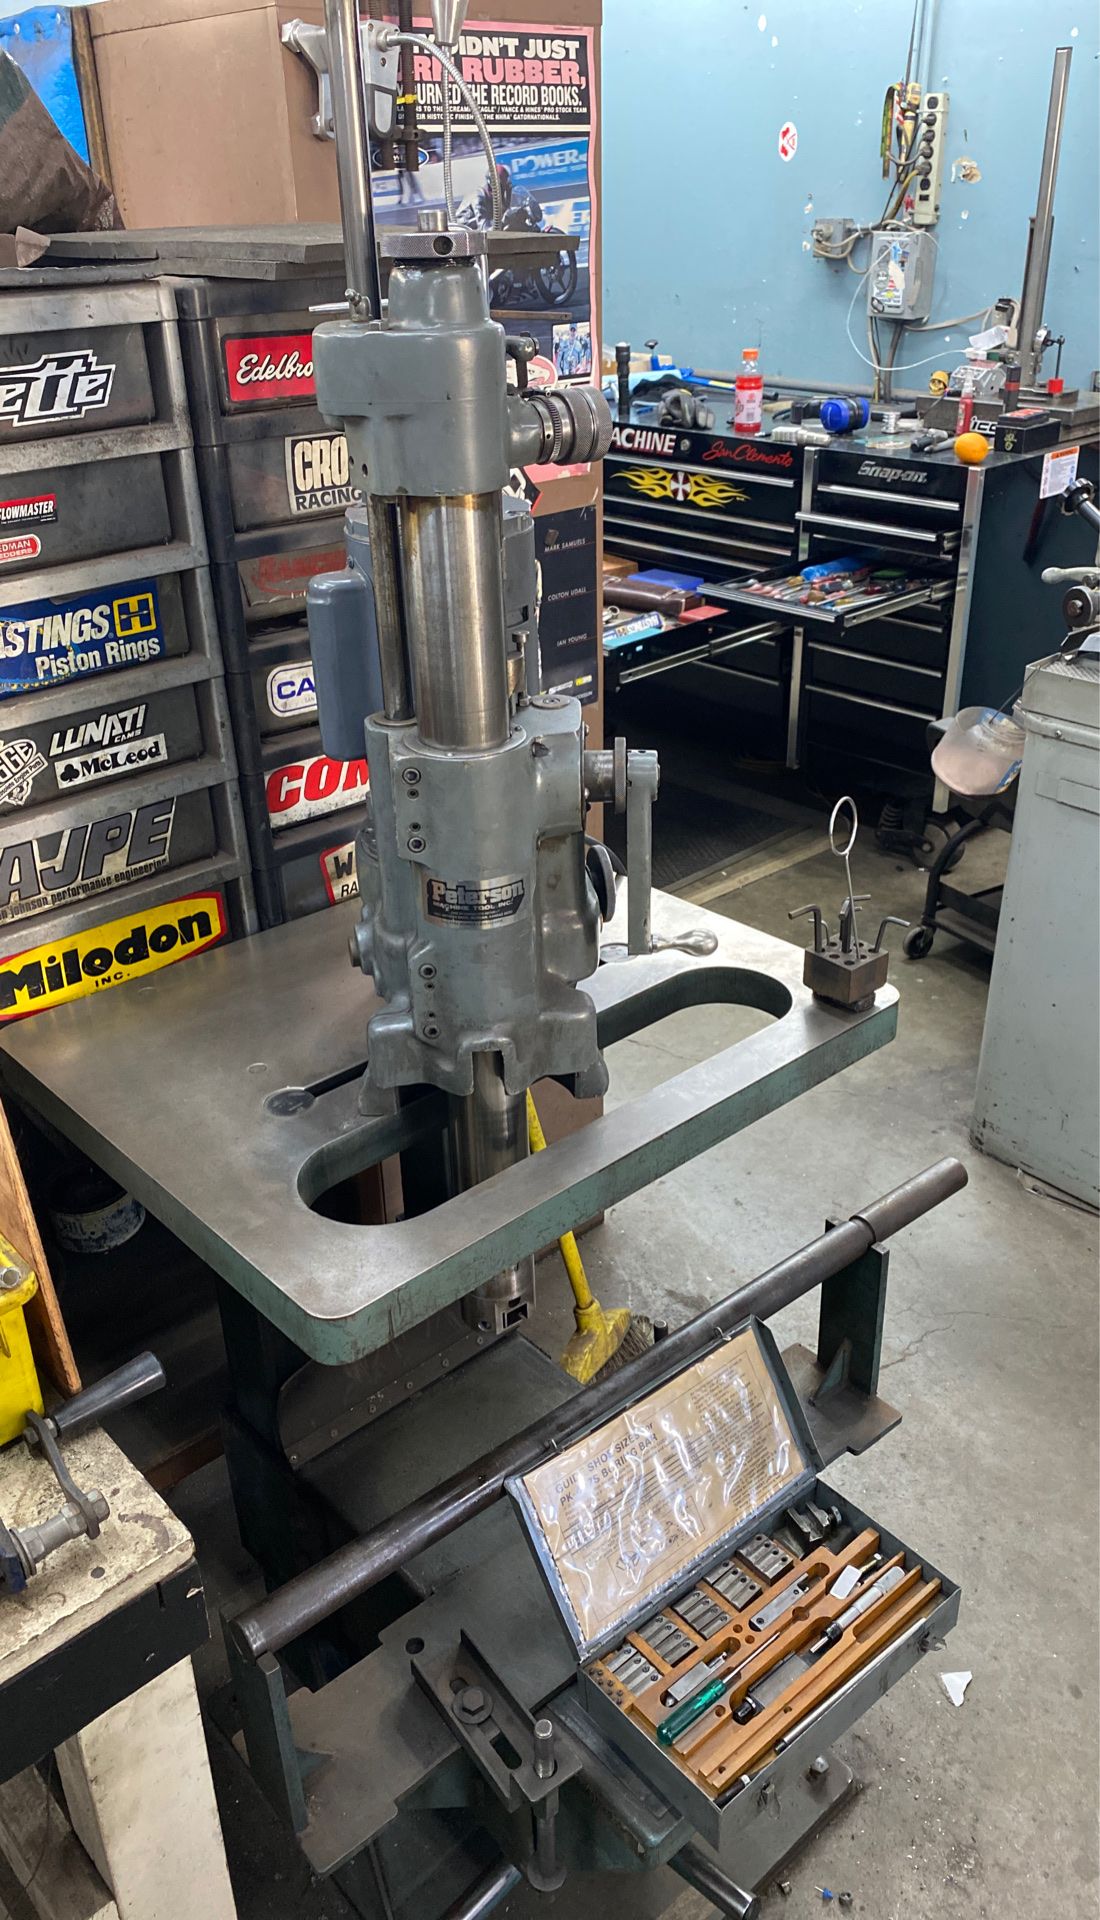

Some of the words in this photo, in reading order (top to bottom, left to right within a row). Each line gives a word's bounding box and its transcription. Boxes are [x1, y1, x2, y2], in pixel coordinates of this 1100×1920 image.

[450, 36, 519, 57] IDN'T
[523, 38, 580, 60] JUST
[462, 56, 586, 89] RUBBER,
[467, 84, 488, 105] HE
[490, 84, 538, 106] RECORD
[541, 86, 582, 106] BOOKS.
[236, 351, 313, 384] Edelbro
[612, 428, 676, 454] ACHINE
[294, 436, 350, 491] CRO
[296, 488, 362, 511] RACING
[0, 539, 31, 552] DMAN
[0, 604, 111, 659] STINGS
[35, 647, 101, 680] Piston
[105, 637, 161, 664] Rings
[50, 704, 147, 756] LUNATI
[114, 729, 142, 744] CAMS
[80, 741, 161, 777] McLeod
[10, 896, 49, 918] johnson
[51, 876, 112, 906] performance
[430, 880, 523, 904] Peterson
[474, 903, 496, 911] TOOL
[0, 911, 212, 1010] Milodon
[95, 972, 130, 988] INC.
